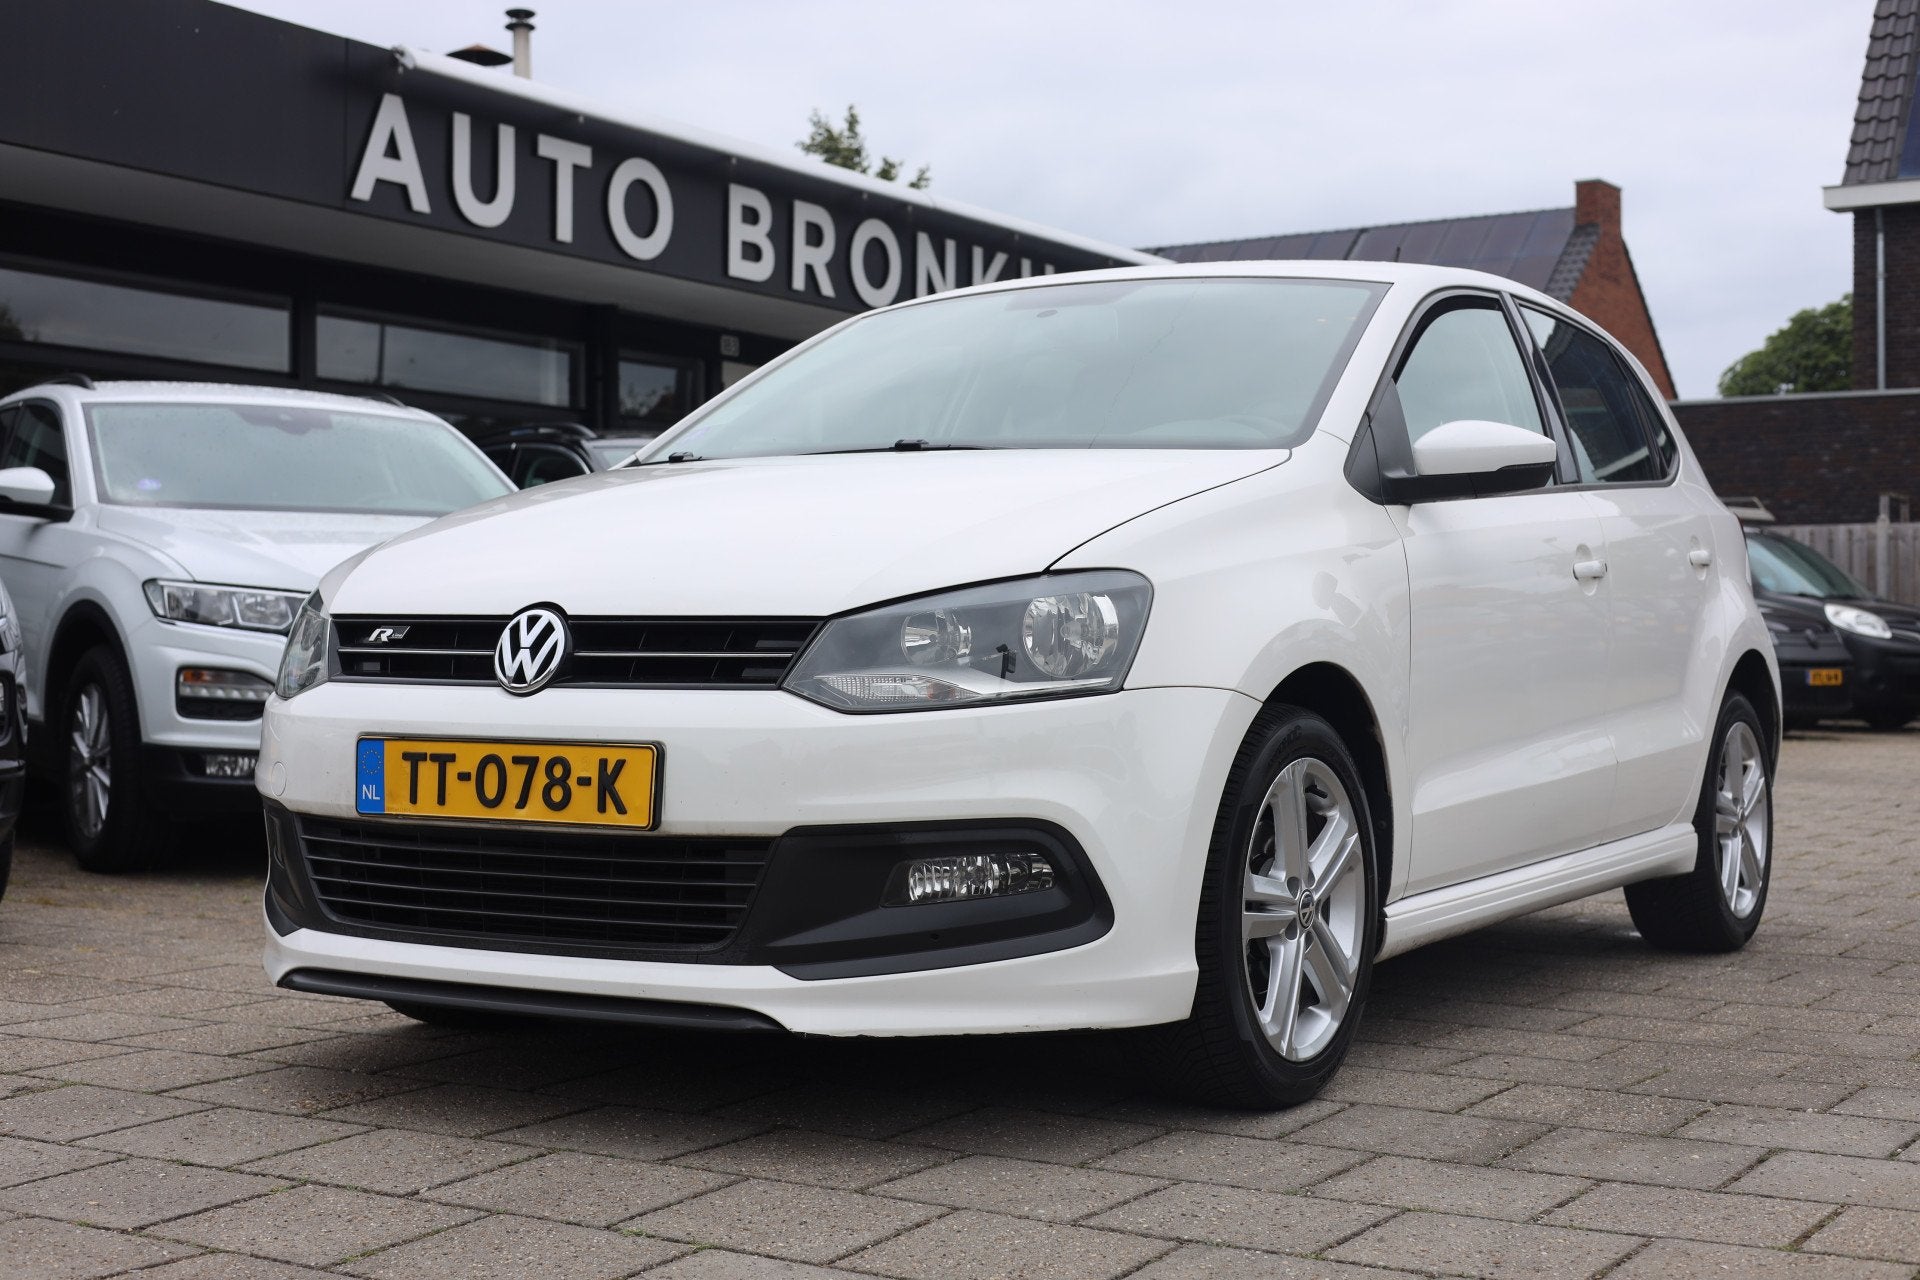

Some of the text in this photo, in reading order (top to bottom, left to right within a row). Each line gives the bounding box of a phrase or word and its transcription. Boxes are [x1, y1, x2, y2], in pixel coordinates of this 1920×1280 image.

[351, 93, 674, 260] AUTO
[362, 751, 627, 814] NL TT-078-K
